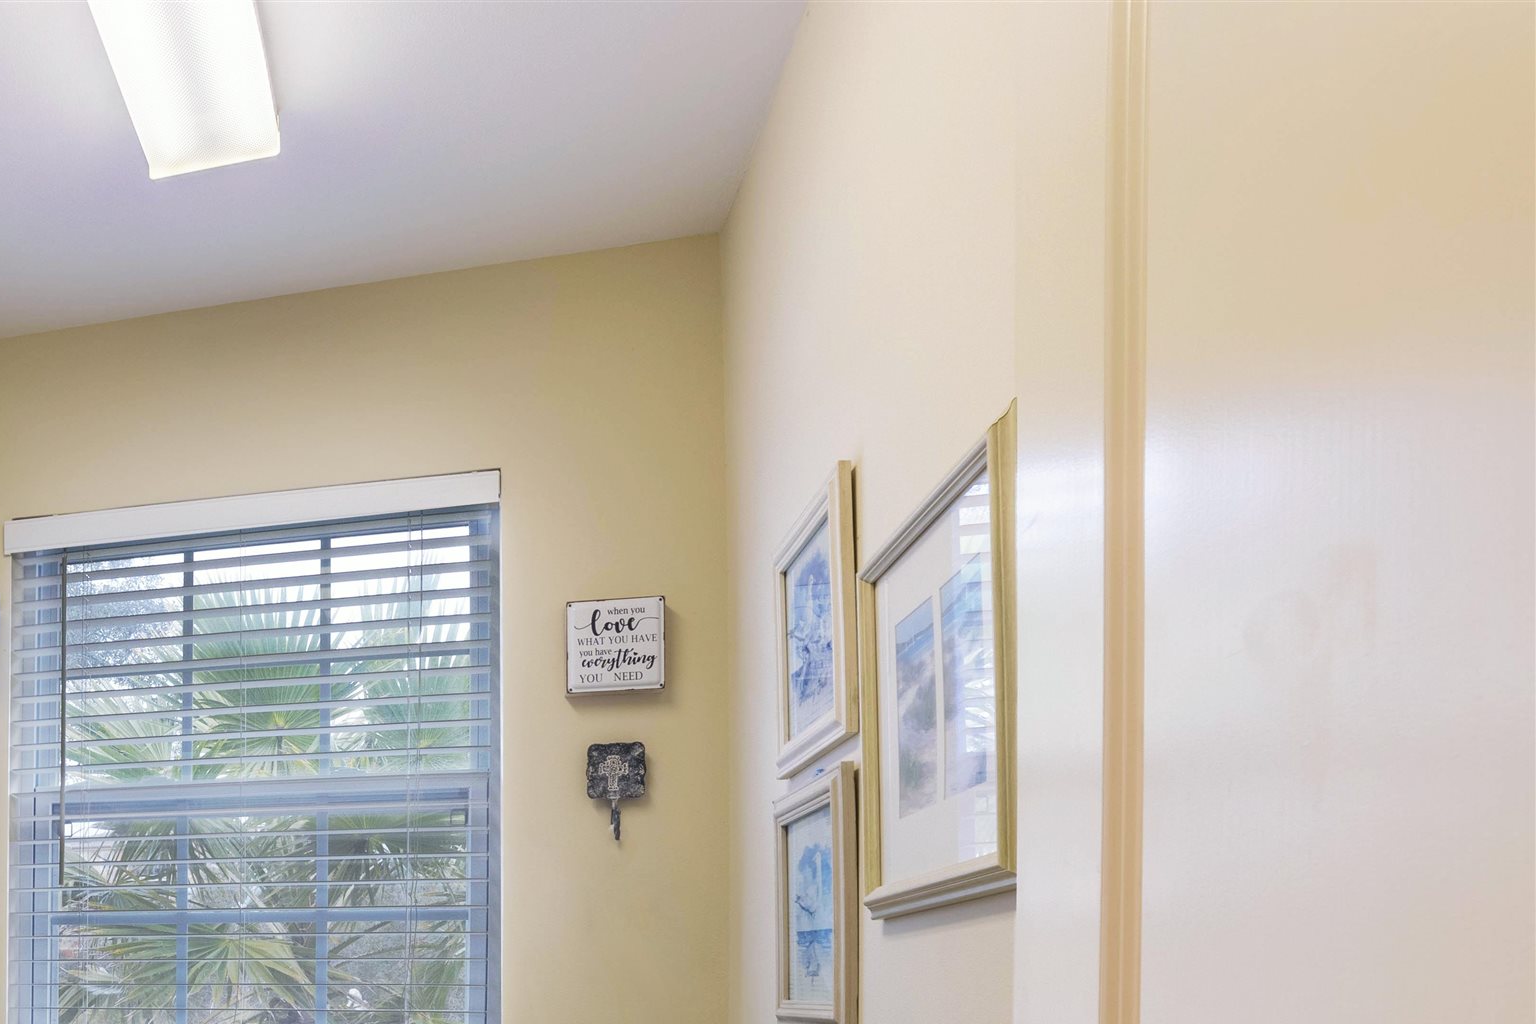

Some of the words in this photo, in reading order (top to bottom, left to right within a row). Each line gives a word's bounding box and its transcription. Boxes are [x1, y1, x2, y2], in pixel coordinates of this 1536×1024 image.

[607, 607, 629, 615] when
[631, 607, 646, 616] you
[574, 609, 660, 636] love
[577, 637, 605, 646] WHAT
[608, 635, 628, 645] YOU
[631, 633, 658, 643] HAVE
[579, 649, 593, 658] you
[595, 648, 612, 656] have
[581, 648, 657, 672] everything
[579, 673, 603, 684] YOU
[613, 671, 644, 682] NEED
